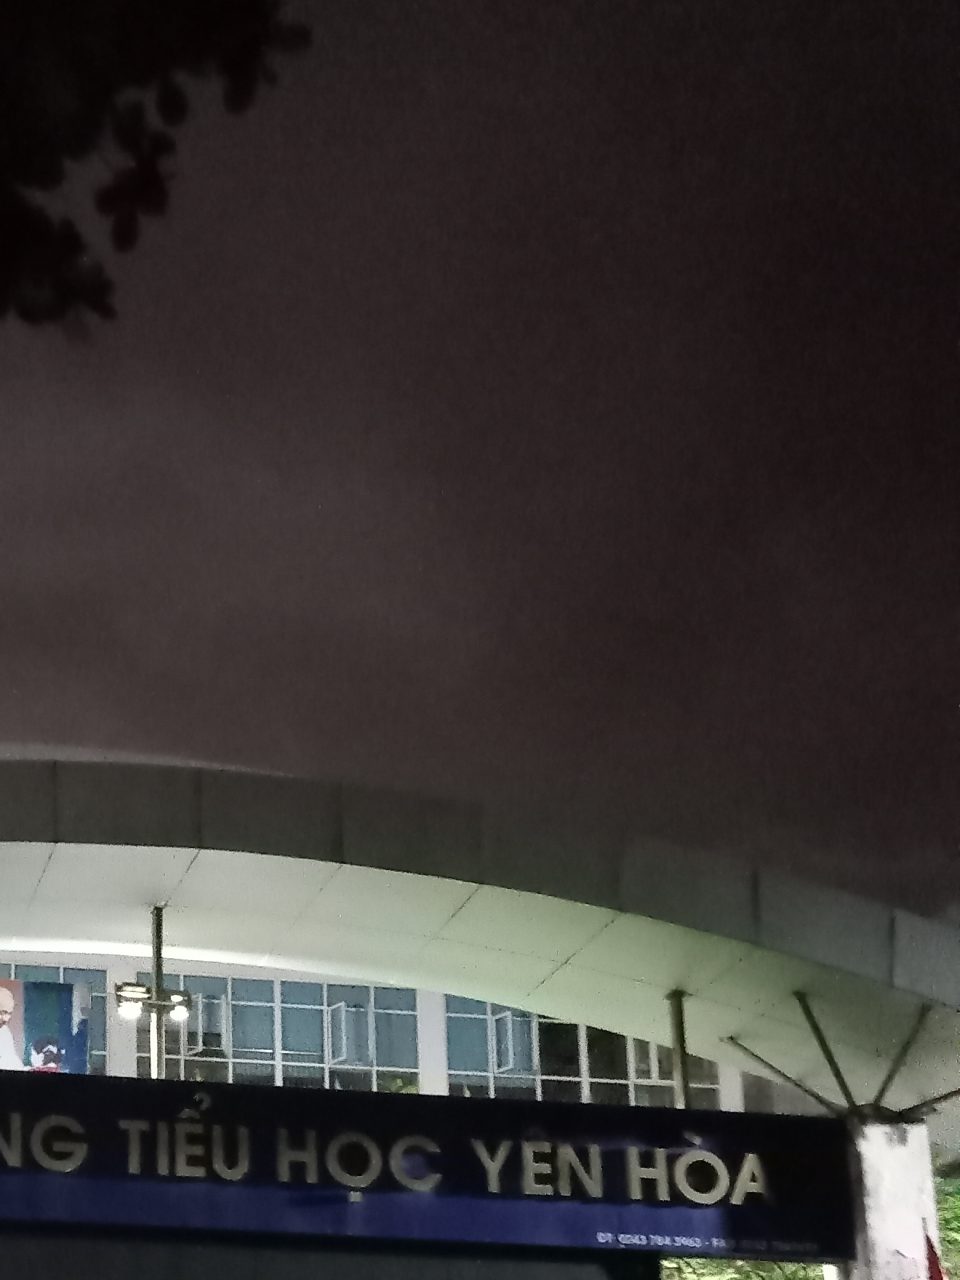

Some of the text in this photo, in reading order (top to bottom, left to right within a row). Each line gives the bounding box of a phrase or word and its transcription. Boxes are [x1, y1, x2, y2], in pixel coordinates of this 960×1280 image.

[119, 1091, 251, 1182] TIỂU
[277, 1128, 442, 1203] HỌC
[471, 1126, 603, 1199] YÊN
[626, 1131, 769, 1206] HÒA
